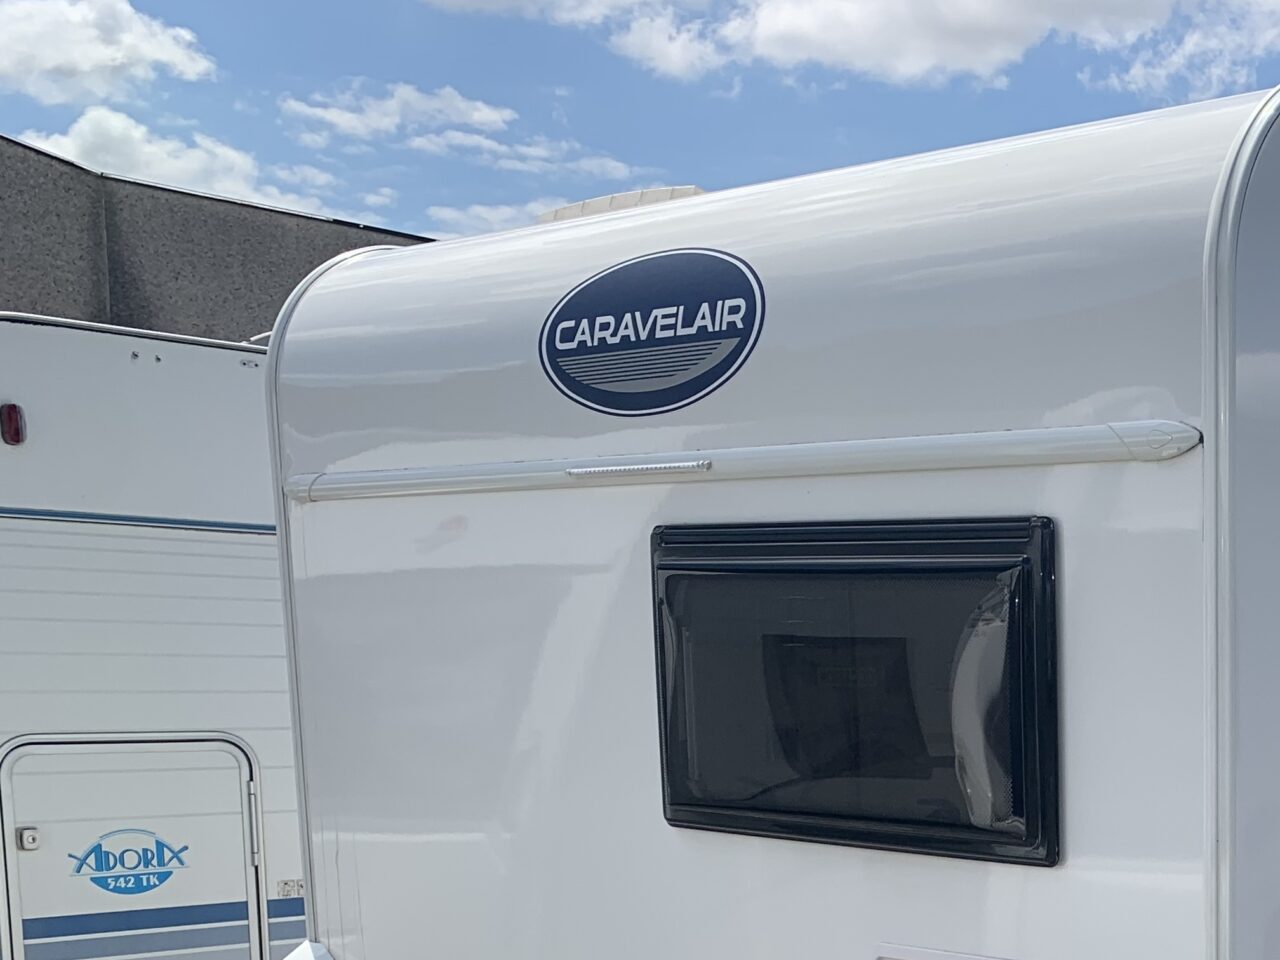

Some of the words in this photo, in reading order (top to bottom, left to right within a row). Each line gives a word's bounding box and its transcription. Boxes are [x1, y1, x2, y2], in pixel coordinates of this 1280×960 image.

[555, 297, 746, 350] CARAVELAIR
[107, 875, 136, 890] 542
[140, 873, 160, 887] TK
